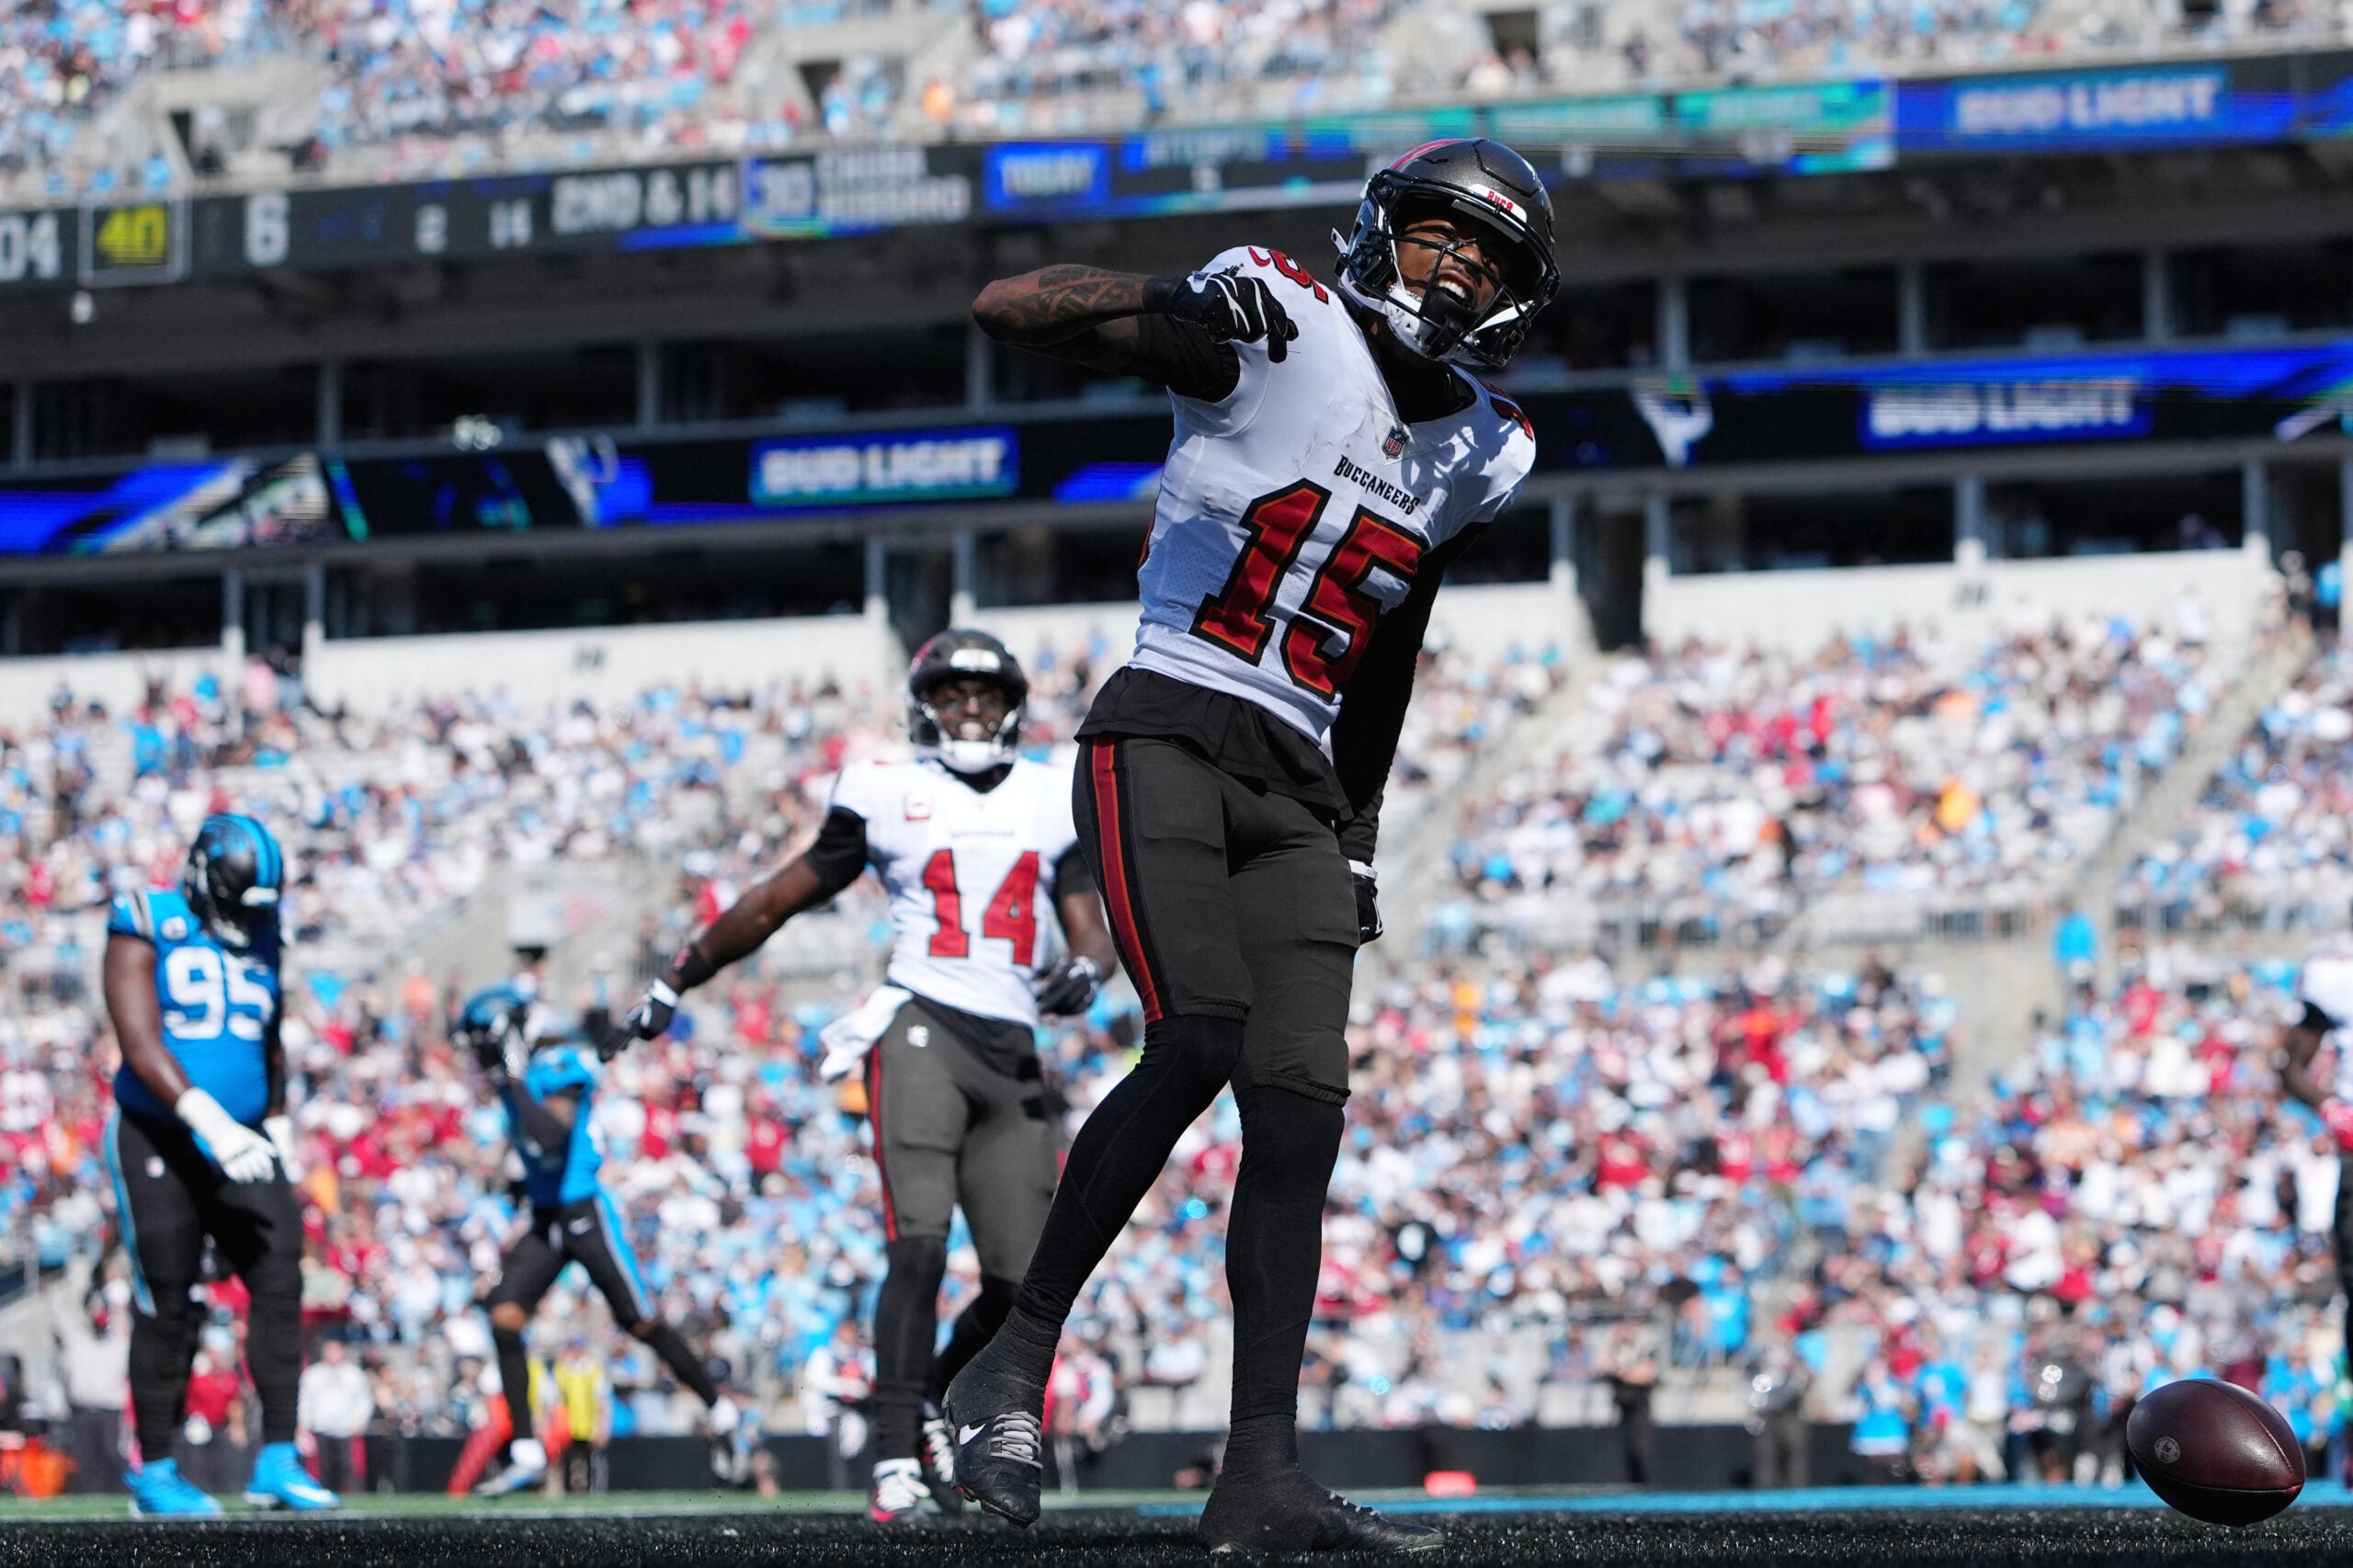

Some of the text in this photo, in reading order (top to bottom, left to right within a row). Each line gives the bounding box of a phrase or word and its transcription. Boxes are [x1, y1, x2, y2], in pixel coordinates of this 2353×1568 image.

[1958, 73, 2219, 134] BUD LIGHT
[97, 204, 168, 266] 40
[244, 193, 290, 267] 6
[1870, 378, 2134, 437] BUD LIGHT
[762, 436, 1007, 495] BUD LIGHT
[1333, 454, 1421, 516] BUCCANEERS
[1188, 477, 1434, 705] 15
[922, 847, 1040, 966] 14
[163, 945, 275, 1040] 95
